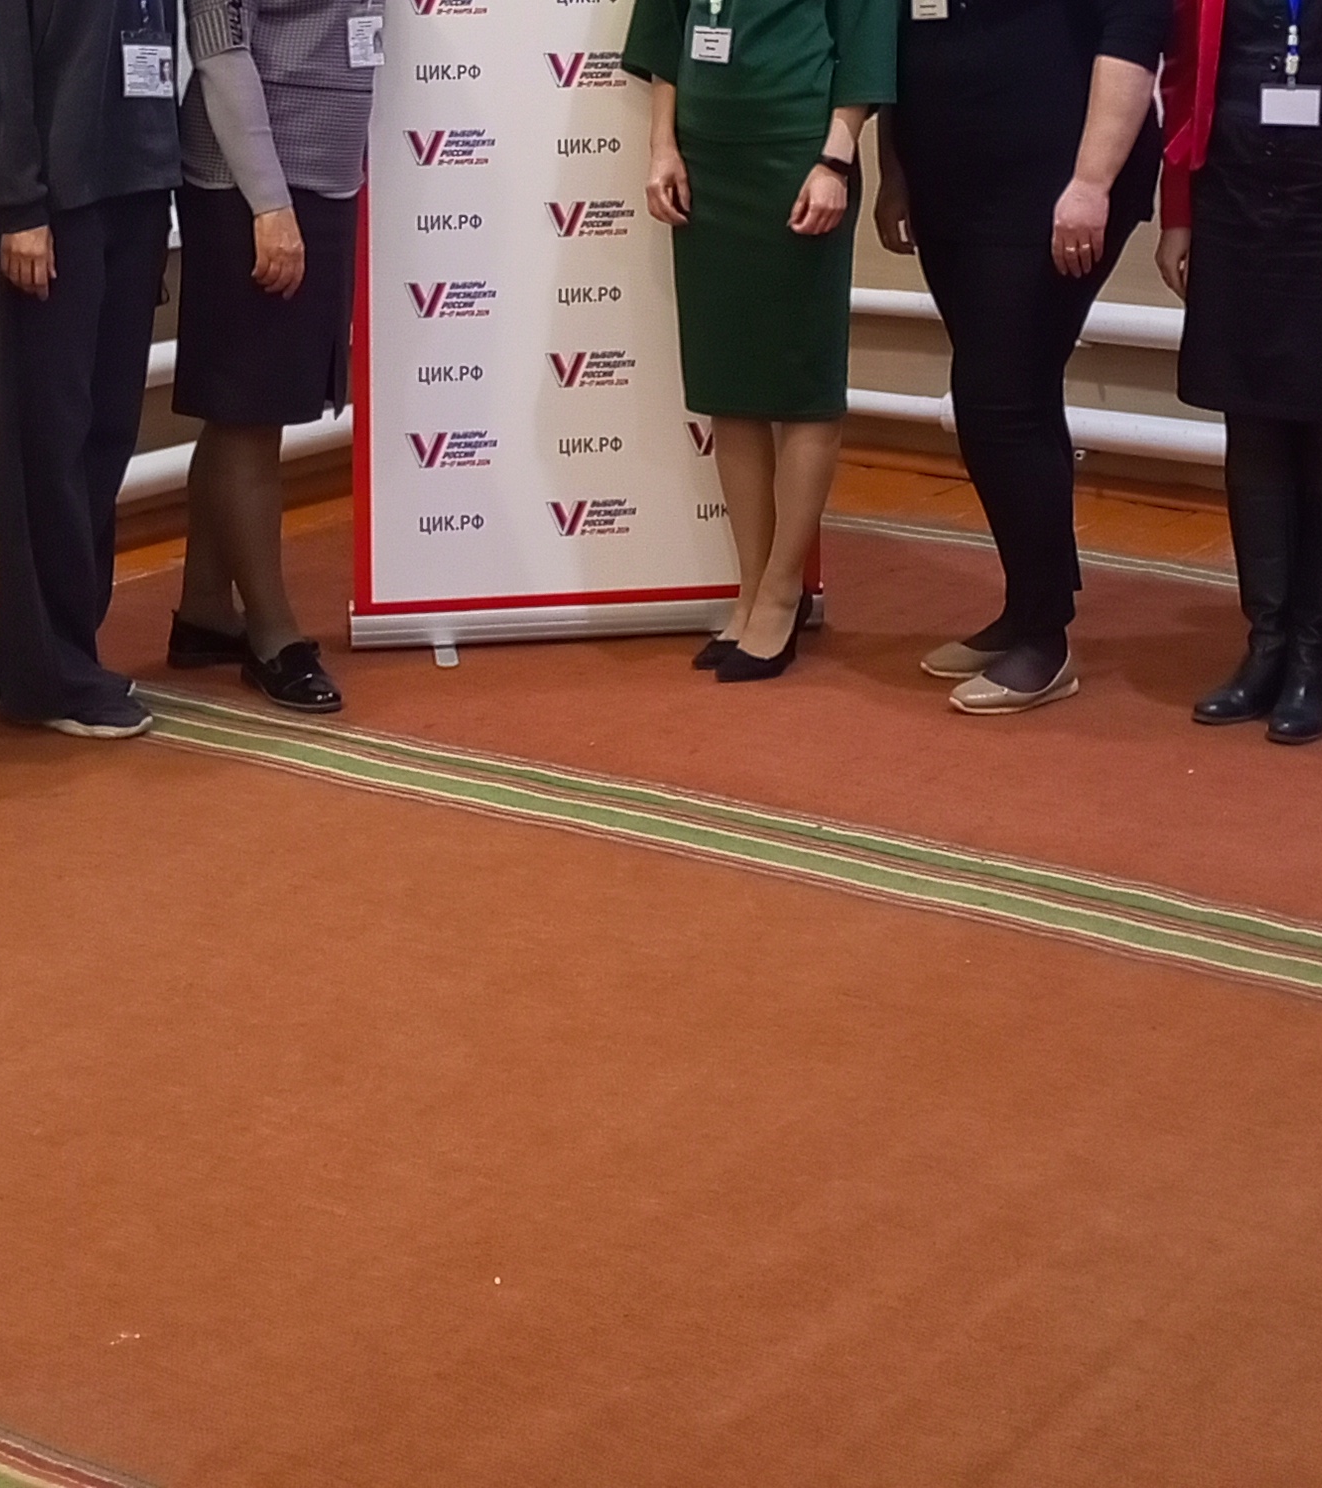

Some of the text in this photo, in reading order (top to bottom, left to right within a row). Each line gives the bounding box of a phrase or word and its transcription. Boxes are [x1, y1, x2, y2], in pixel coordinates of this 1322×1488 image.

[416, 64, 481, 84] ЦИК.РФ
[580, 71, 613, 79] РОССИИ
[449, 129, 485, 137] ВЫБОРЫ
[445, 139, 495, 148] ПРЕЗИДЕНТА
[557, 137, 621, 158] ЦИК.РФ
[440, 149, 473, 157] РОССИИ
[589, 200, 625, 209] ВЫБОРЫ
[585, 210, 634, 219] ПРЕЗИДЕНТА
[417, 214, 483, 234] ЦИК.РФ
[581, 220, 613, 228] РОССИИ
[450, 281, 486, 289] ВЫБОРЫ
[446, 290, 496, 300] ПРЕЗИДЕНТА
[558, 286, 622, 307] ЦИК.РФ
[442, 301, 474, 309] РОССИИ
[590, 350, 626, 359] ВЫБОРЫ
[586, 360, 635, 369] ПРЕЗИДЕНТА
[418, 365, 483, 386] ЦИК.РФ
[582, 370, 614, 378] РОССИИ
[451, 431, 487, 439] ВЫБОРЫ
[447, 440, 497, 450] ПРЕЗИДЕНТА
[559, 436, 623, 457] ЦИК.РФ
[443, 451, 475, 459] РОССИИ
[591, 499, 626, 507] ВЫБОРЫ
[587, 508, 636, 518] ПРЕЗИДЕНТА
[697, 503, 729, 521] ЦИК
[419, 513, 484, 535] ЦИК.РФ
[583, 519, 615, 527] РОССИИ
